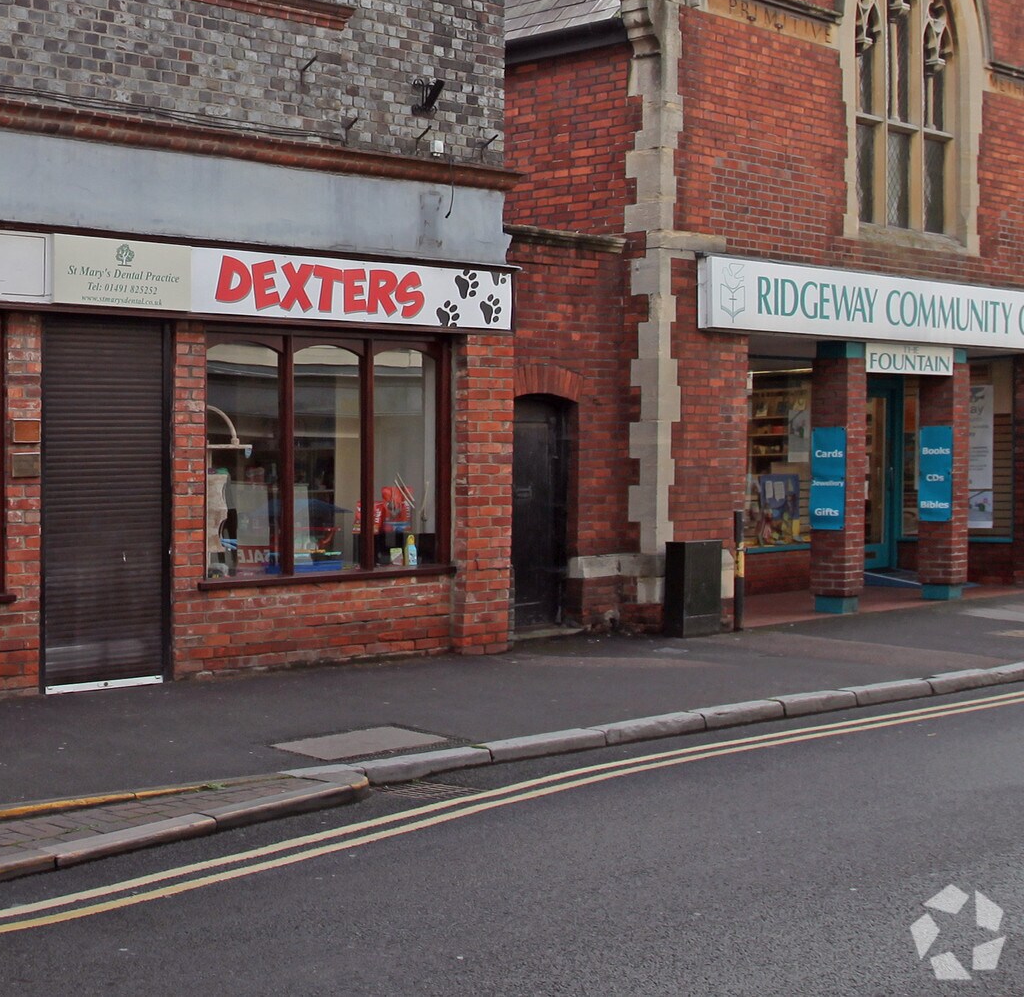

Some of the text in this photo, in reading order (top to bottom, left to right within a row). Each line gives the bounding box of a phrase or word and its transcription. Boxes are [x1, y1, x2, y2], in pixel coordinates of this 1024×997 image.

[67, 264, 180, 284] St Mary's Dental Practice
[87, 281, 158, 295] Tel: 01491 825252
[215, 255, 426, 319] DEXTERS
[81, 294, 163, 306] www.stmarysdental.co.uk
[757, 275, 878, 324] RIDGEWAY
[886, 289, 1013, 335] COMMUNITY
[903, 345, 919, 354] THE
[869, 352, 950, 372] FOUNTAIN
[815, 449, 844, 458] Cards
[922, 447, 951, 455] Books
[926, 474, 945, 482] CDs
[920, 500, 950, 509] Bibles
[814, 507, 840, 517] Gifts
